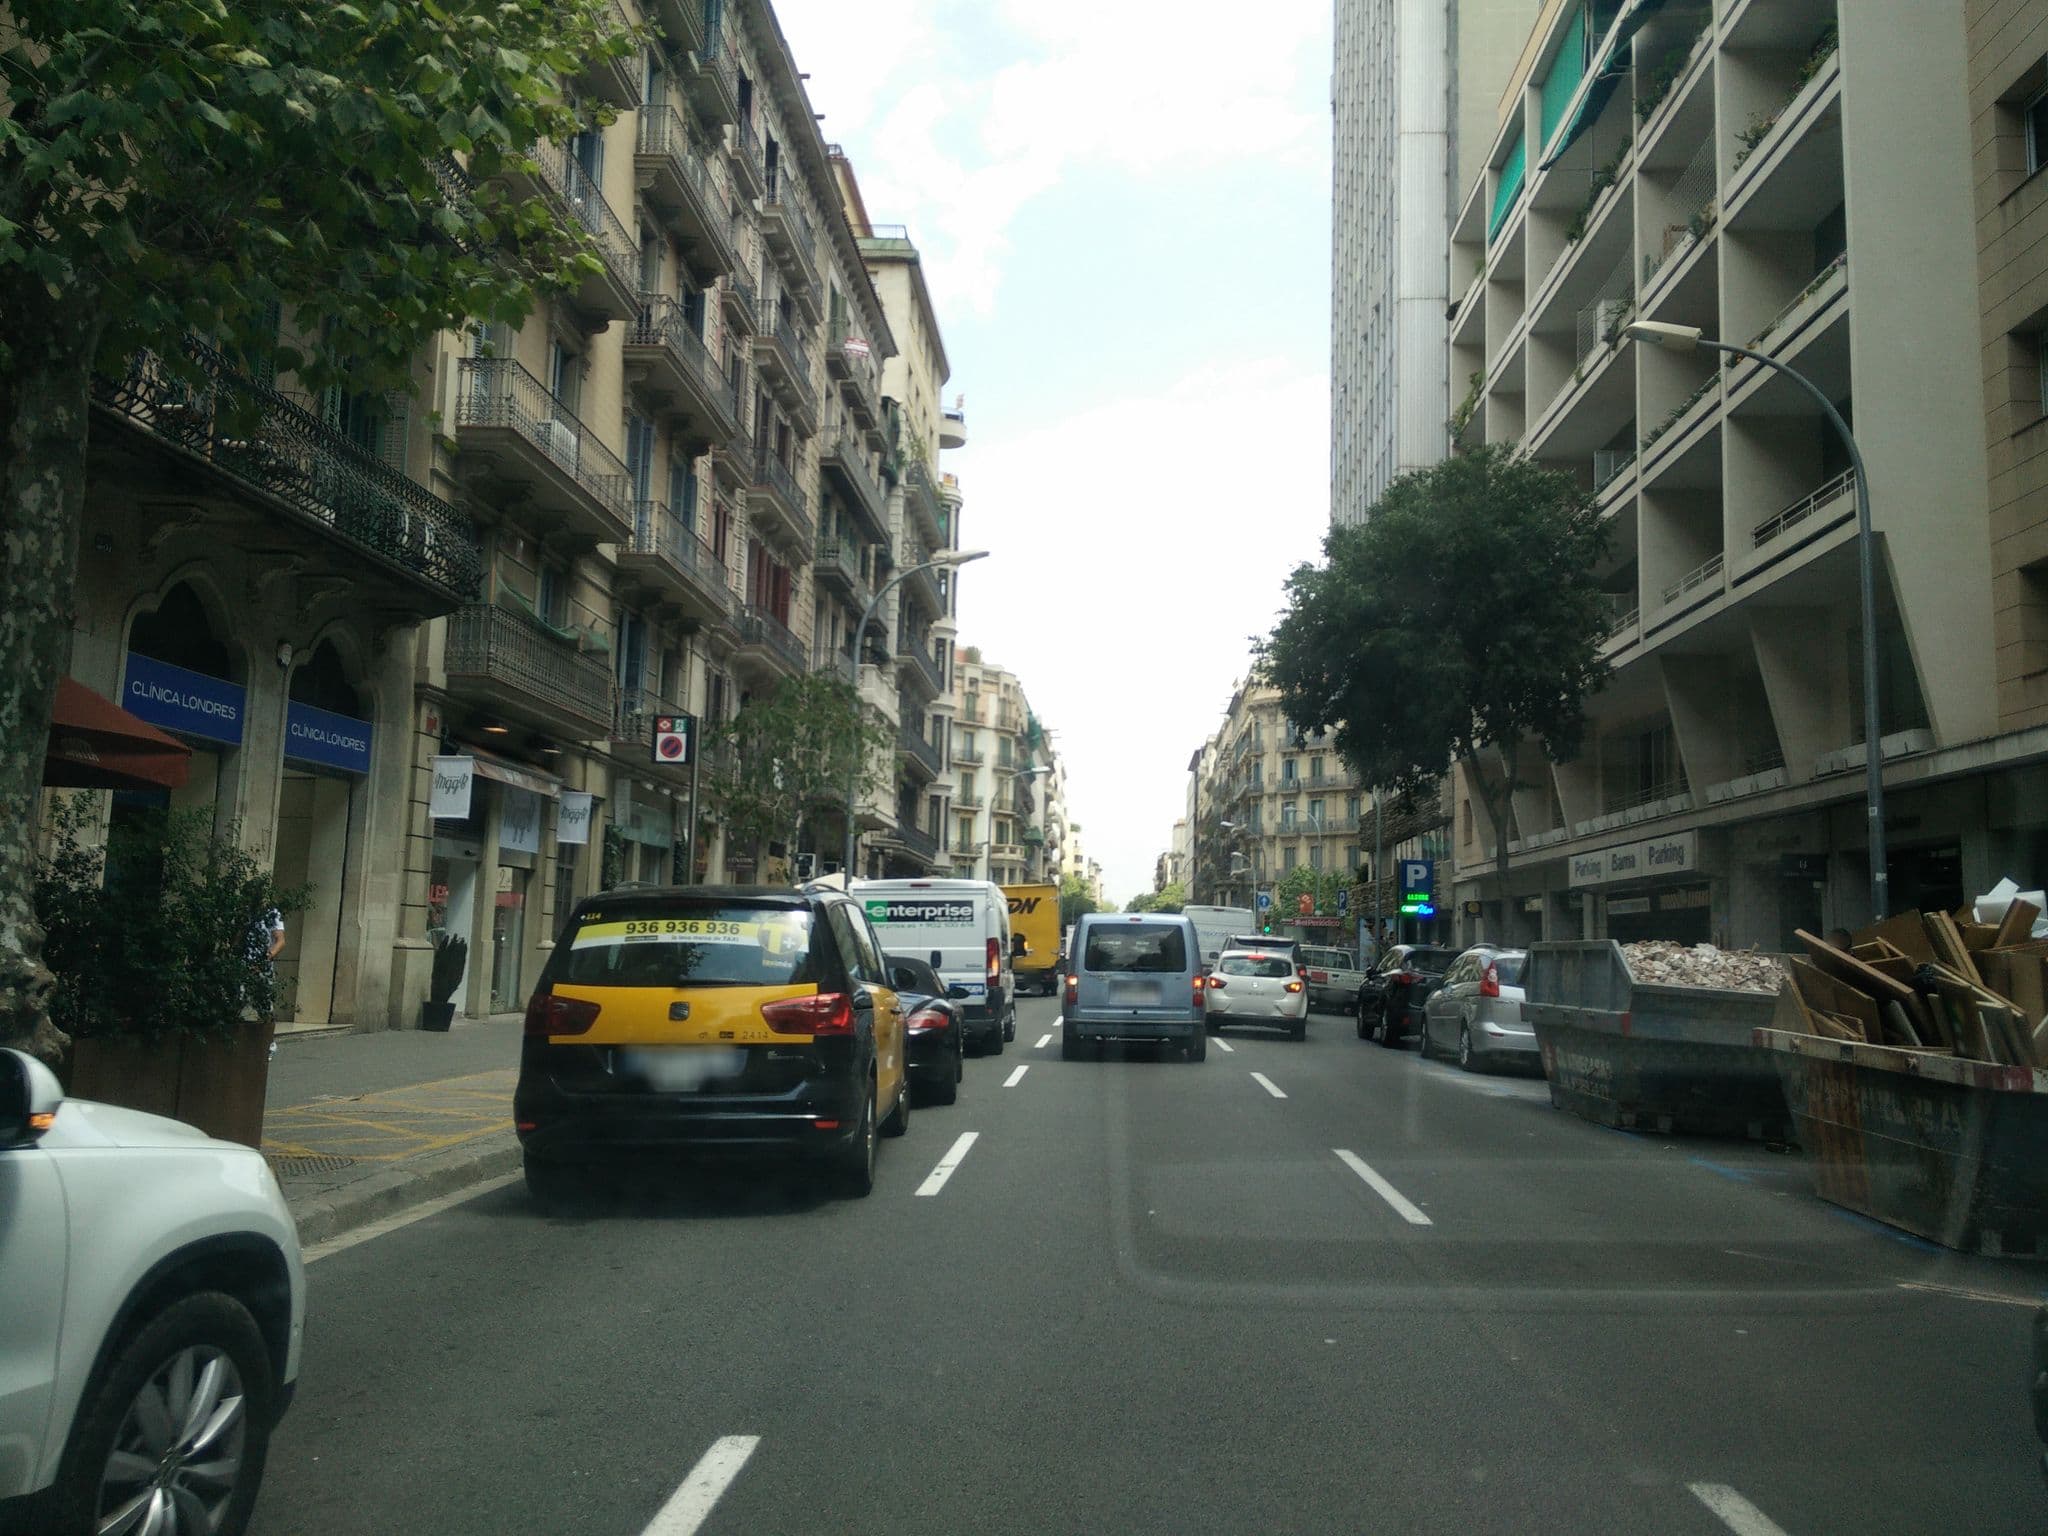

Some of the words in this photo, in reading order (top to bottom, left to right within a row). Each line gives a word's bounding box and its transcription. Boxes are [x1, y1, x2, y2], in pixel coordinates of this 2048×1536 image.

[131, 681, 180, 705] CLÍNICA
[182, 696, 236, 720] LONDRES
[291, 723, 326, 742] CLÍNICA
[327, 733, 366, 752] LONDRES
[1574, 859, 1601, 878] Parking
[1648, 842, 1685, 866] Parking
[1406, 864, 1428, 888] P
[870, 904, 973, 920] enterprise
[626, 922, 659, 934] 936
[665, 921, 699, 933] 936
[706, 922, 740, 935] 936
